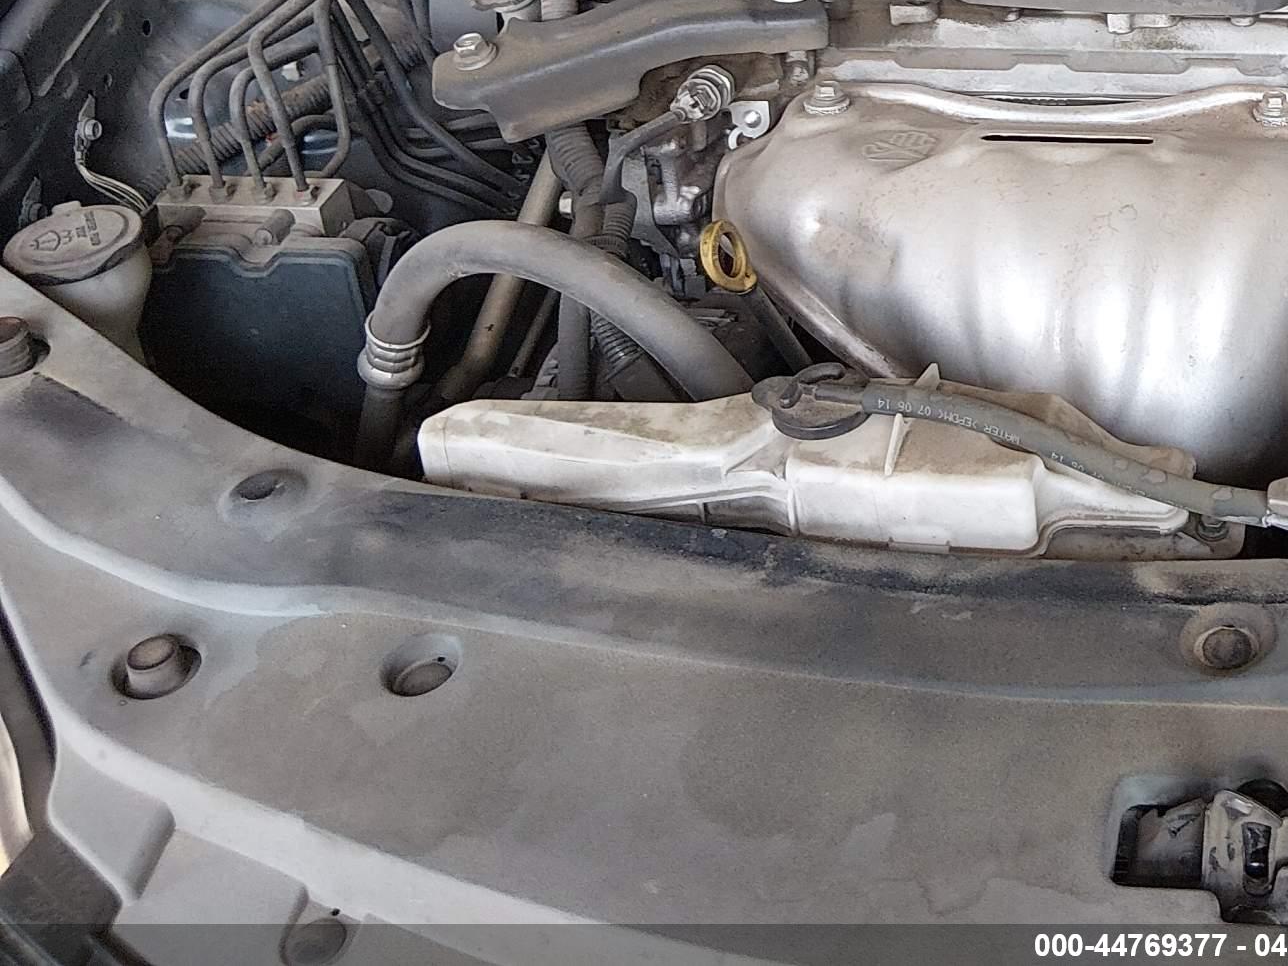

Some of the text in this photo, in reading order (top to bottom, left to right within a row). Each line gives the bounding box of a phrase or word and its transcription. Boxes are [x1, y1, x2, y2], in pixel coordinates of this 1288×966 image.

[877, 397, 891, 411] 14
[917, 404, 932, 418] 07
[983, 424, 1021, 445] WATER
